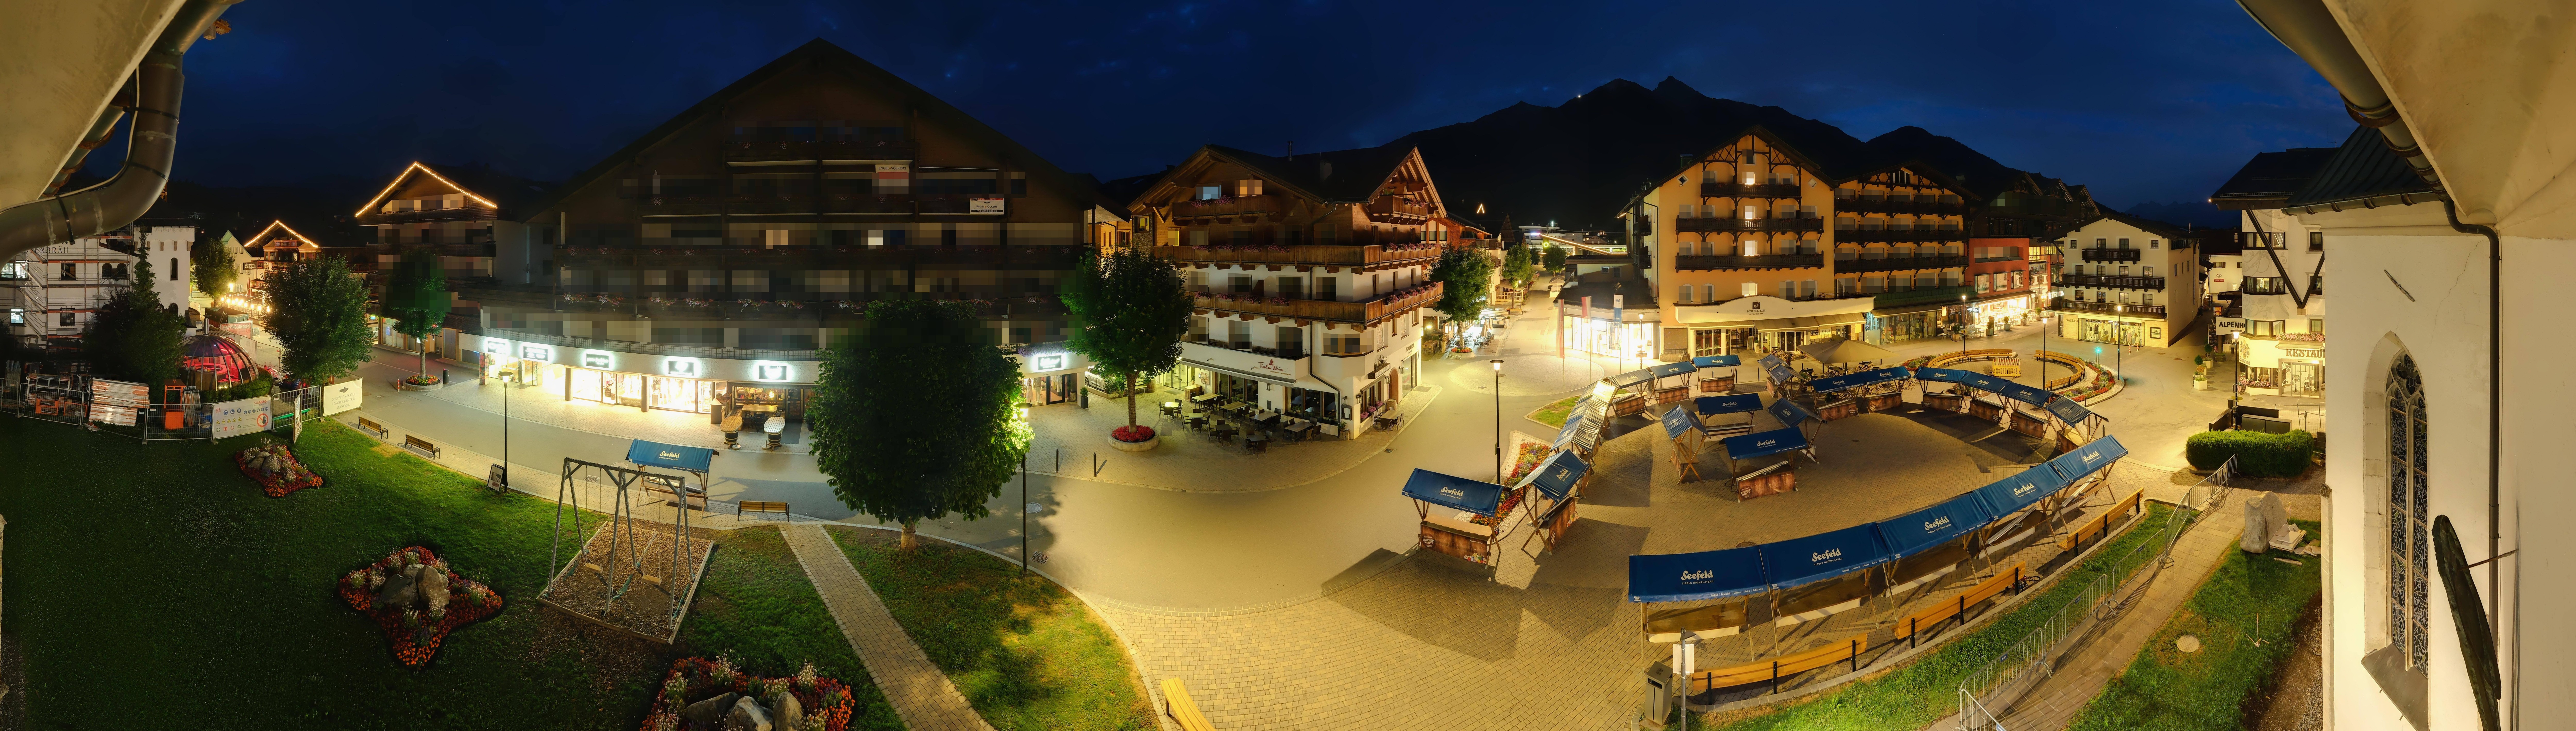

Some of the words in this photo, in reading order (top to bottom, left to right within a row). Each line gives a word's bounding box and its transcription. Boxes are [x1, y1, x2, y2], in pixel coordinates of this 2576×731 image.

[1375, 364, 1390, 378] RESTAURANT
[332, 397, 355, 406] KONGRESSZENTRUM
[2083, 451, 2099, 462] Seefeld
[1556, 468, 1569, 480] Seefeld
[1440, 486, 1464, 497] Seefeld
[2014, 482, 2034, 495] Seefeld
[1925, 515, 1949, 531] Seefeld
[1812, 548, 1842, 562] Seefeld
[1681, 569, 1714, 581] Seefeld
